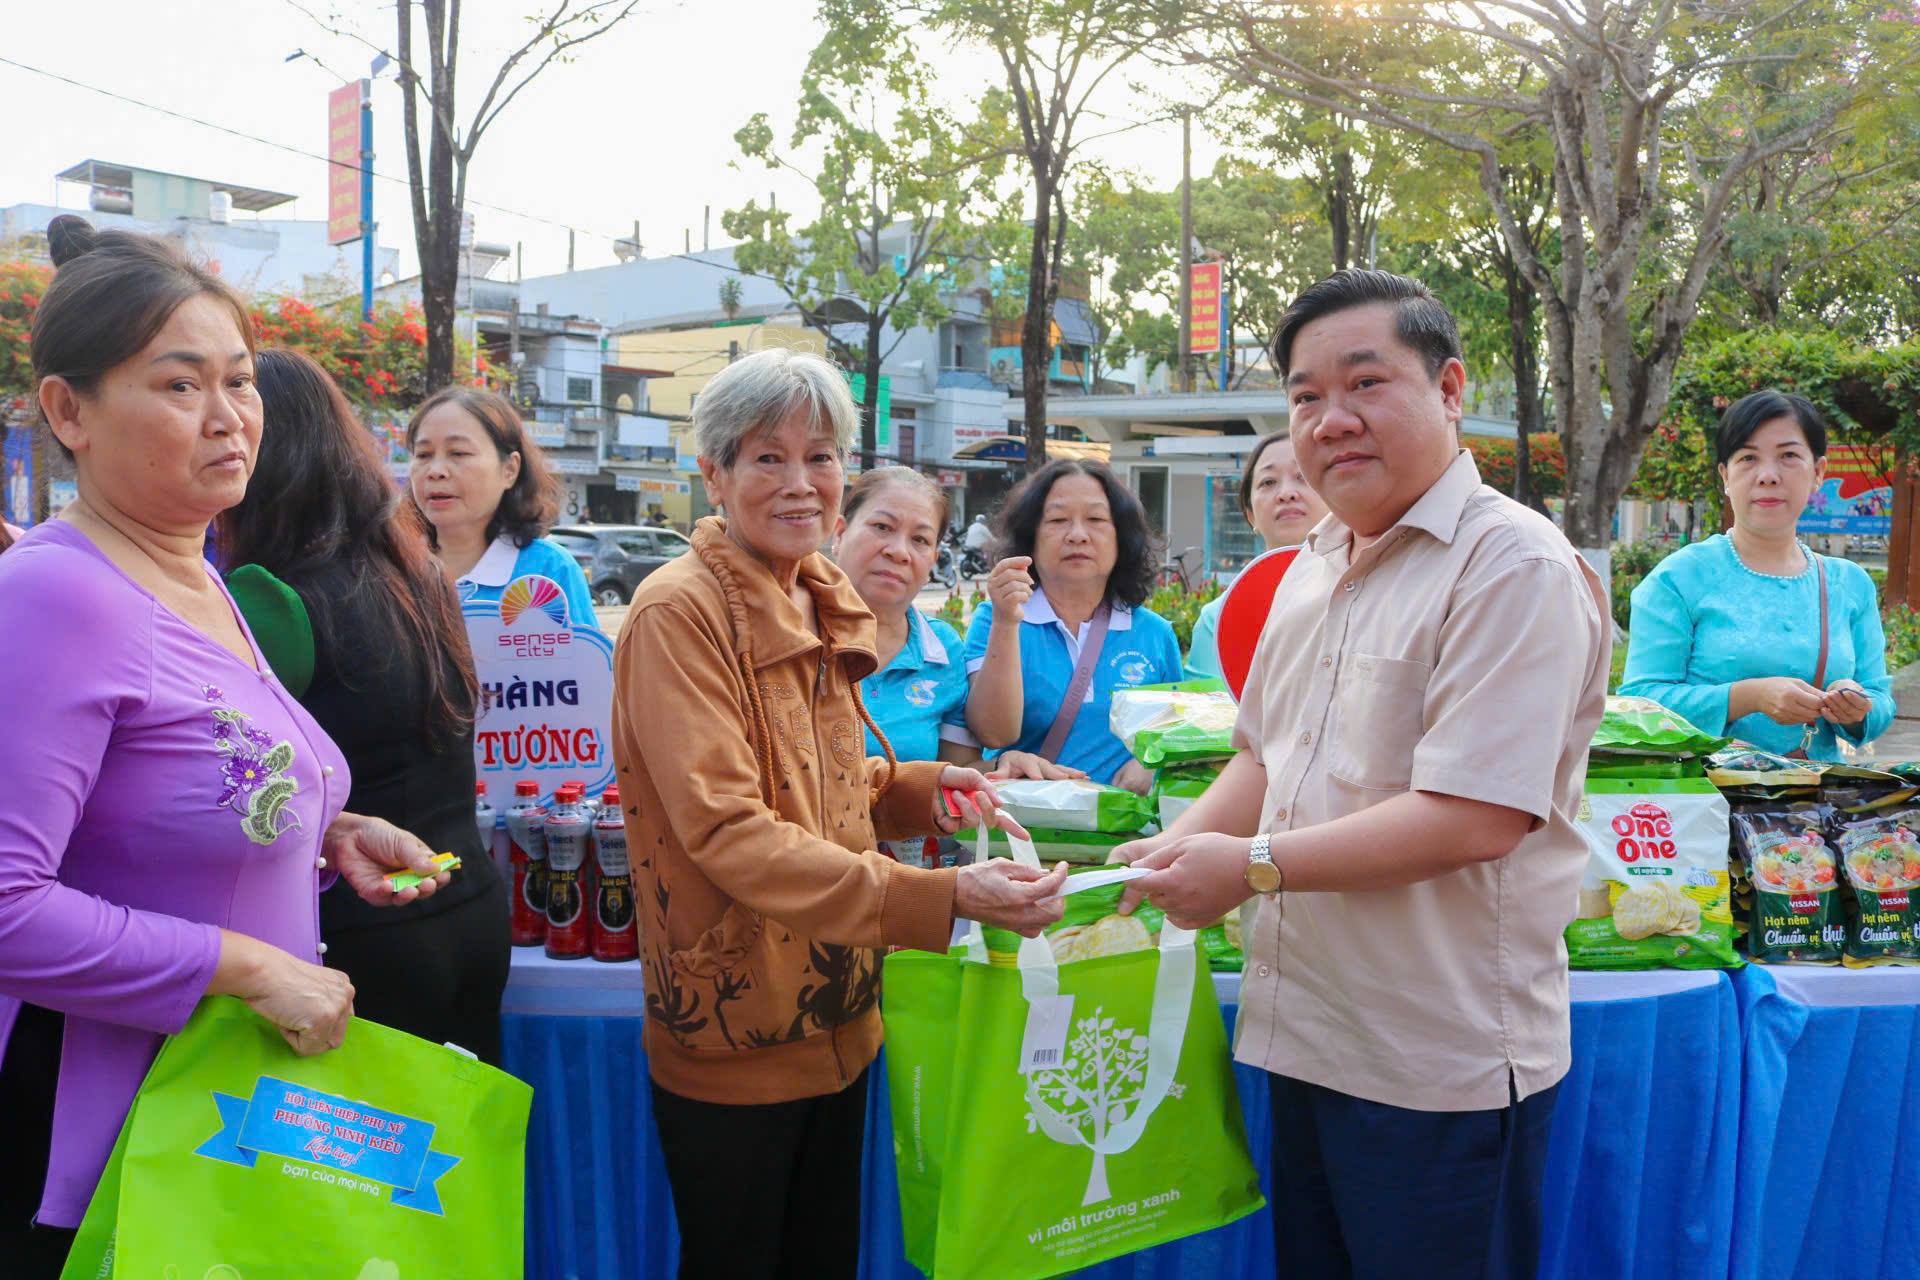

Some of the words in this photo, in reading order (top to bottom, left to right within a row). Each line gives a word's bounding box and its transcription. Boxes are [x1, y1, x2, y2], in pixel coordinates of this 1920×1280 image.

[498, 633, 571, 647] sense
[516, 646, 554, 657] city
[482, 674, 579, 711] HÀNG
[477, 723, 598, 765] TƯƠNG
[1611, 814, 1673, 838] One
[1616, 837, 1678, 863] One
[1789, 900, 1821, 908] VISSAN
[1878, 896, 1910, 906] VISSAN
[1764, 916, 1785, 928] Hạt
[1862, 913, 1876, 925] Hạt
[1764, 927, 1807, 946] Chuẩn
[1809, 931, 1820, 945] vị
[1822, 924, 1846, 949] thịt
[1860, 925, 1900, 943] Chuẩn
[1901, 929, 1913, 943] vị
[285, 1091, 305, 1106] HỘI
[308, 1096, 332, 1114] LIÊN
[334, 1106, 360, 1122] HIỆP
[362, 1115, 386, 1131] PHỤ
[333, 1126, 367, 1145] NINH
[282, 1161, 309, 1178] bạn
[311, 1167, 336, 1184] của
[337, 1175, 358, 1192] mọi
[359, 1181, 381, 1198] nhà
[1027, 1227, 1042, 1244] vì
[1046, 1215, 1077, 1238] môi
[1080, 1201, 1138, 1227] trường
[1142, 1188, 1181, 1209] xanh
